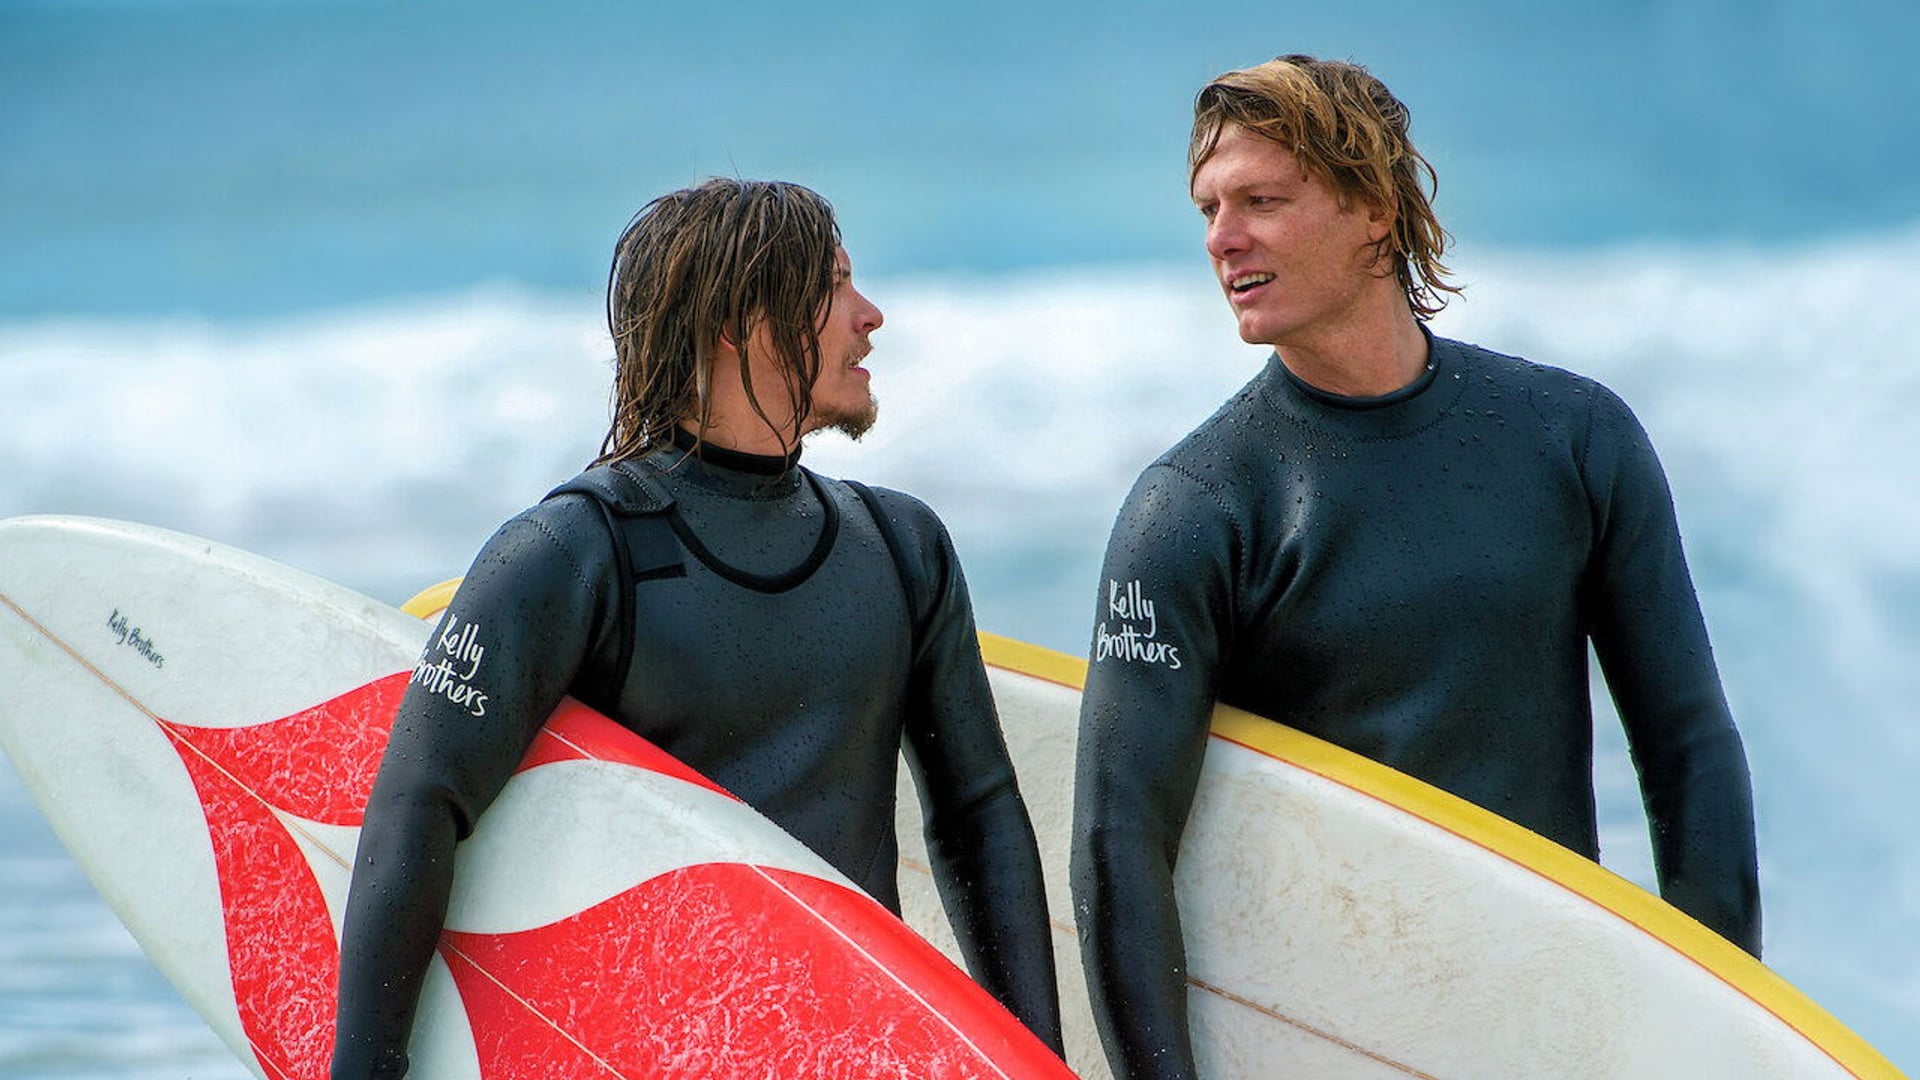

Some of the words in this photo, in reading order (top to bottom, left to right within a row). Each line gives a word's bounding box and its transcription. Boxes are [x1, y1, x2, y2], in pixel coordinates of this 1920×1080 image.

[106, 608, 129, 645] Kelly
[127, 627, 165, 669] Brothers
[1109, 578, 1156, 639] Kelly
[435, 613, 485, 681] Kelly
[1096, 621, 1182, 670] Brothers
